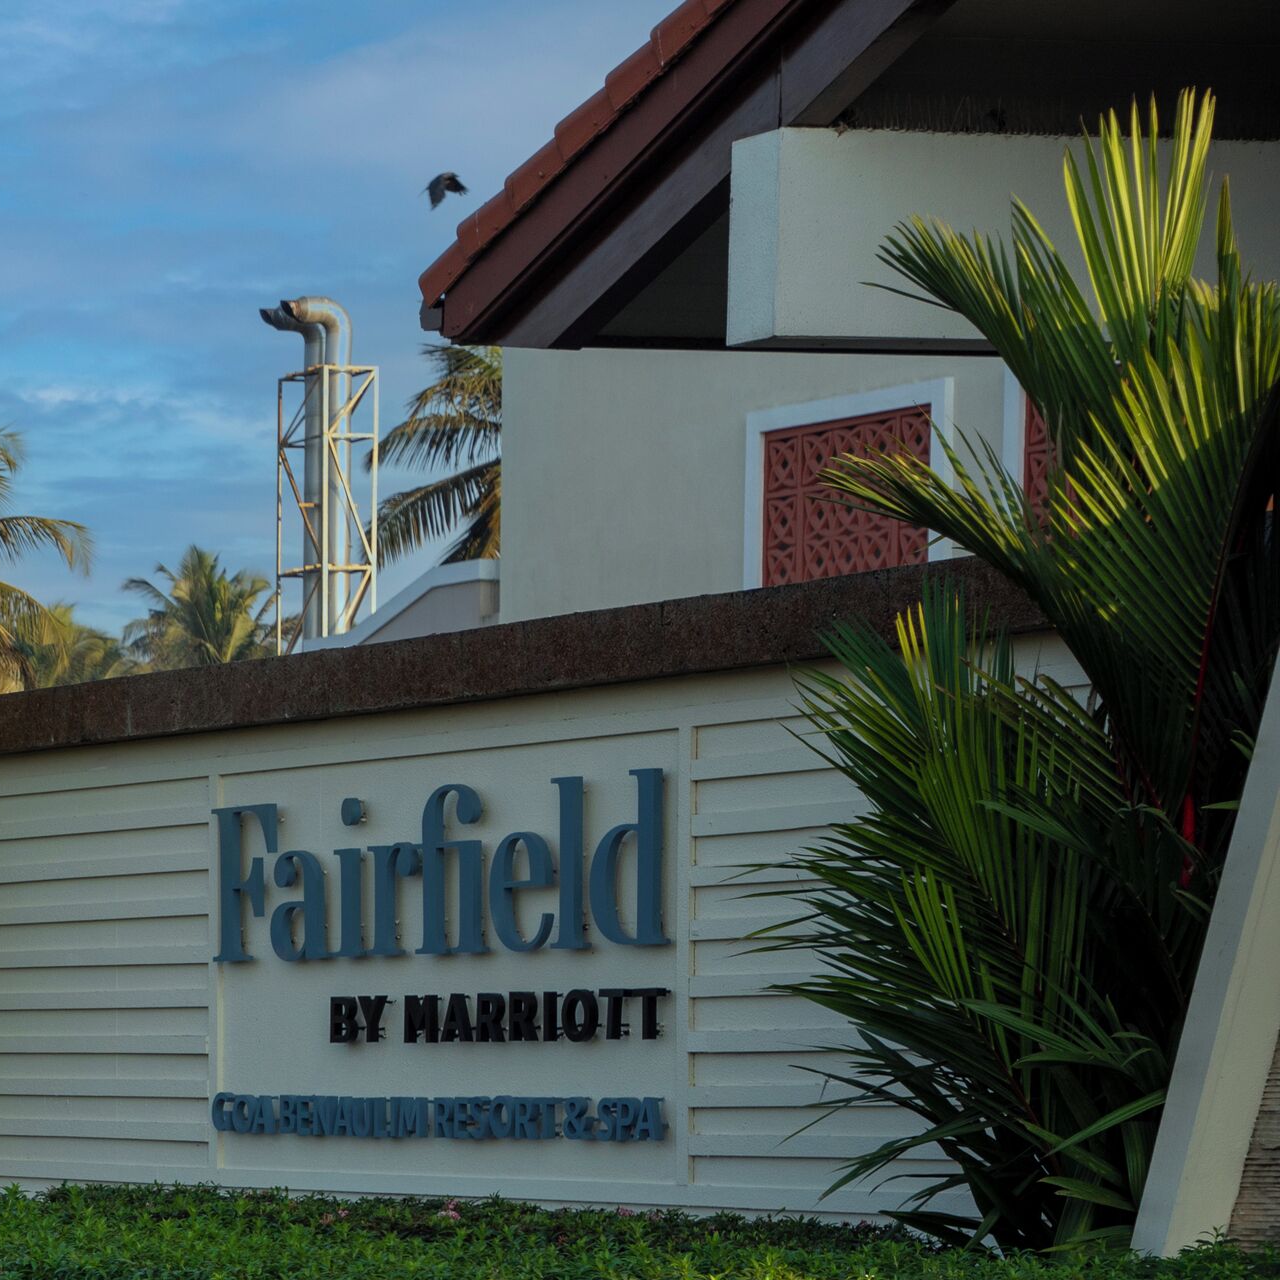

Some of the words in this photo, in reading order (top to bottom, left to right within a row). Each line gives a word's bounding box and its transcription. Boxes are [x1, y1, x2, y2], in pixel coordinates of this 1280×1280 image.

[211, 768, 672, 963] Fairfield
[330, 995, 389, 1043] BY
[403, 987, 670, 1043] MARRIOTT
[212, 1092, 277, 1135] GOA
[278, 1094, 429, 1138] BENAULIM
[433, 1095, 559, 1140] RESORT
[563, 1096, 593, 1141] &
[595, 1097, 667, 1142] SPA
